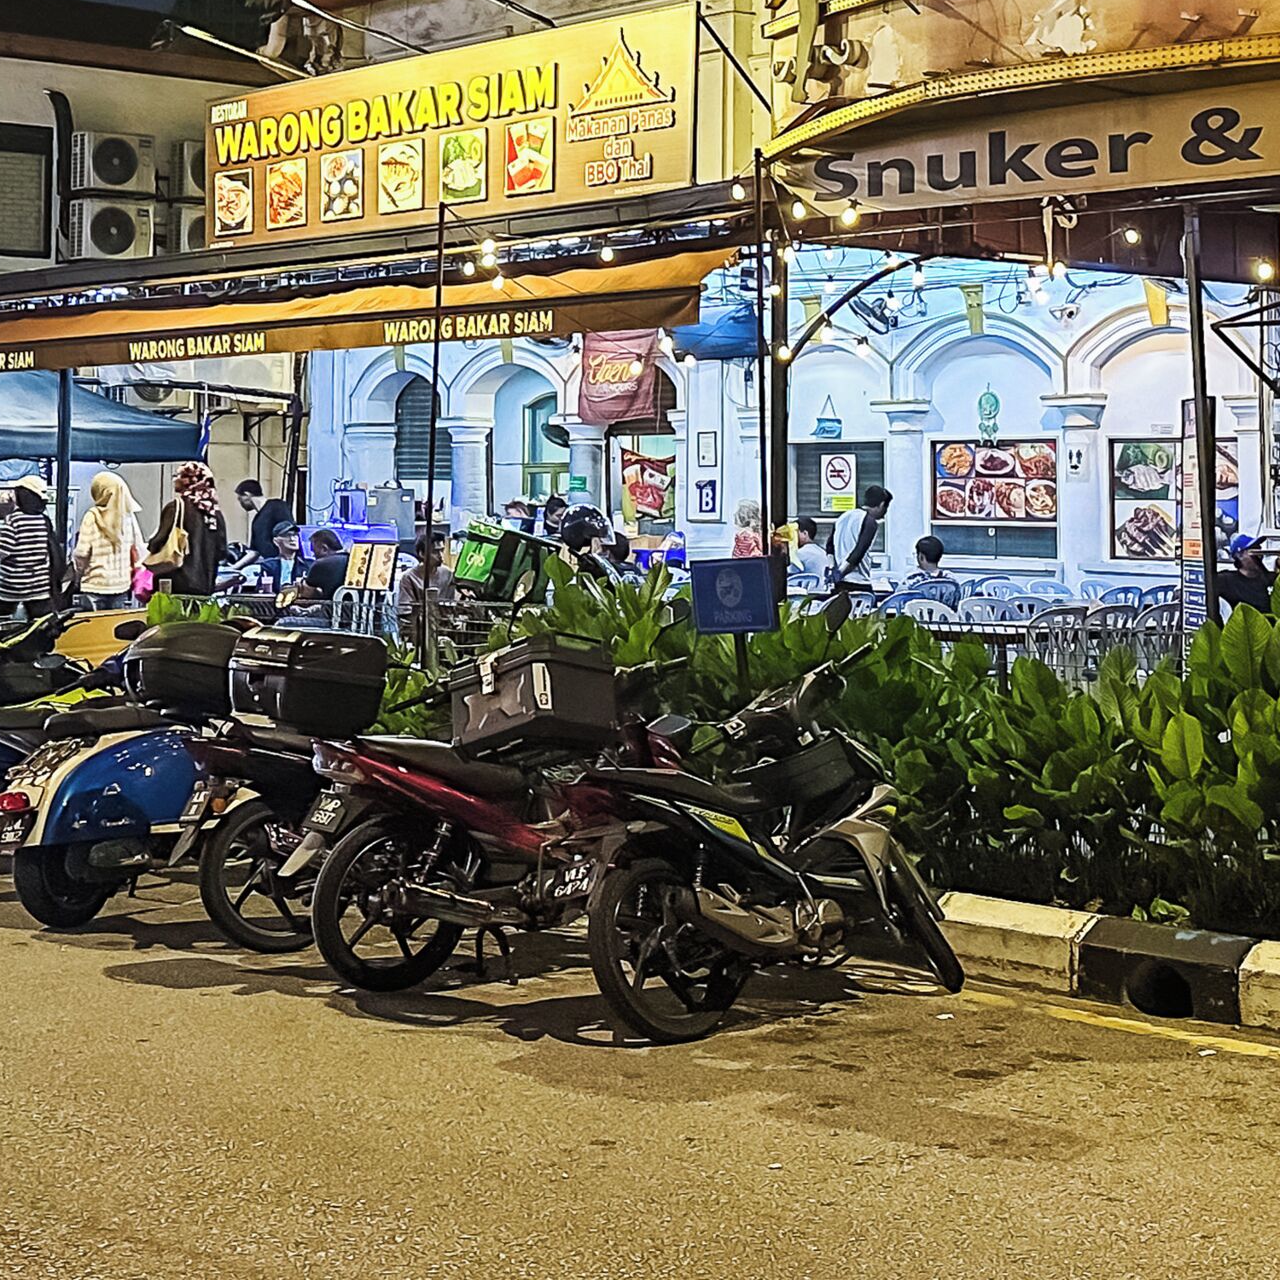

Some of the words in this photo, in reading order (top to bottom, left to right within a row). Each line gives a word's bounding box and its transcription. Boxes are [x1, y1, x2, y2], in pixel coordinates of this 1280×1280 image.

[211, 100, 248, 124] RESTORAN
[215, 104, 344, 165] WARONG
[347, 81, 464, 144] BAKAR
[466, 62, 559, 122] SIAM
[566, 113, 629, 142] Makanan
[629, 106, 676, 132] Panas
[604, 136, 632, 160] dan
[814, 130, 1154, 202] Snuker
[1180, 107, 1264, 166] &
[585, 160, 620, 186] BBQ
[620, 152, 652, 180] Thai
[456, 312, 510, 338] BAKAR
[514, 309, 553, 334] SIAM
[7, 350, 35, 370] SIAM
[129, 338, 185, 361] WARONG
[186, 334, 231, 357] BAKAR
[233, 332, 266, 353] SIAM
[701, 488, 714, 512] B
